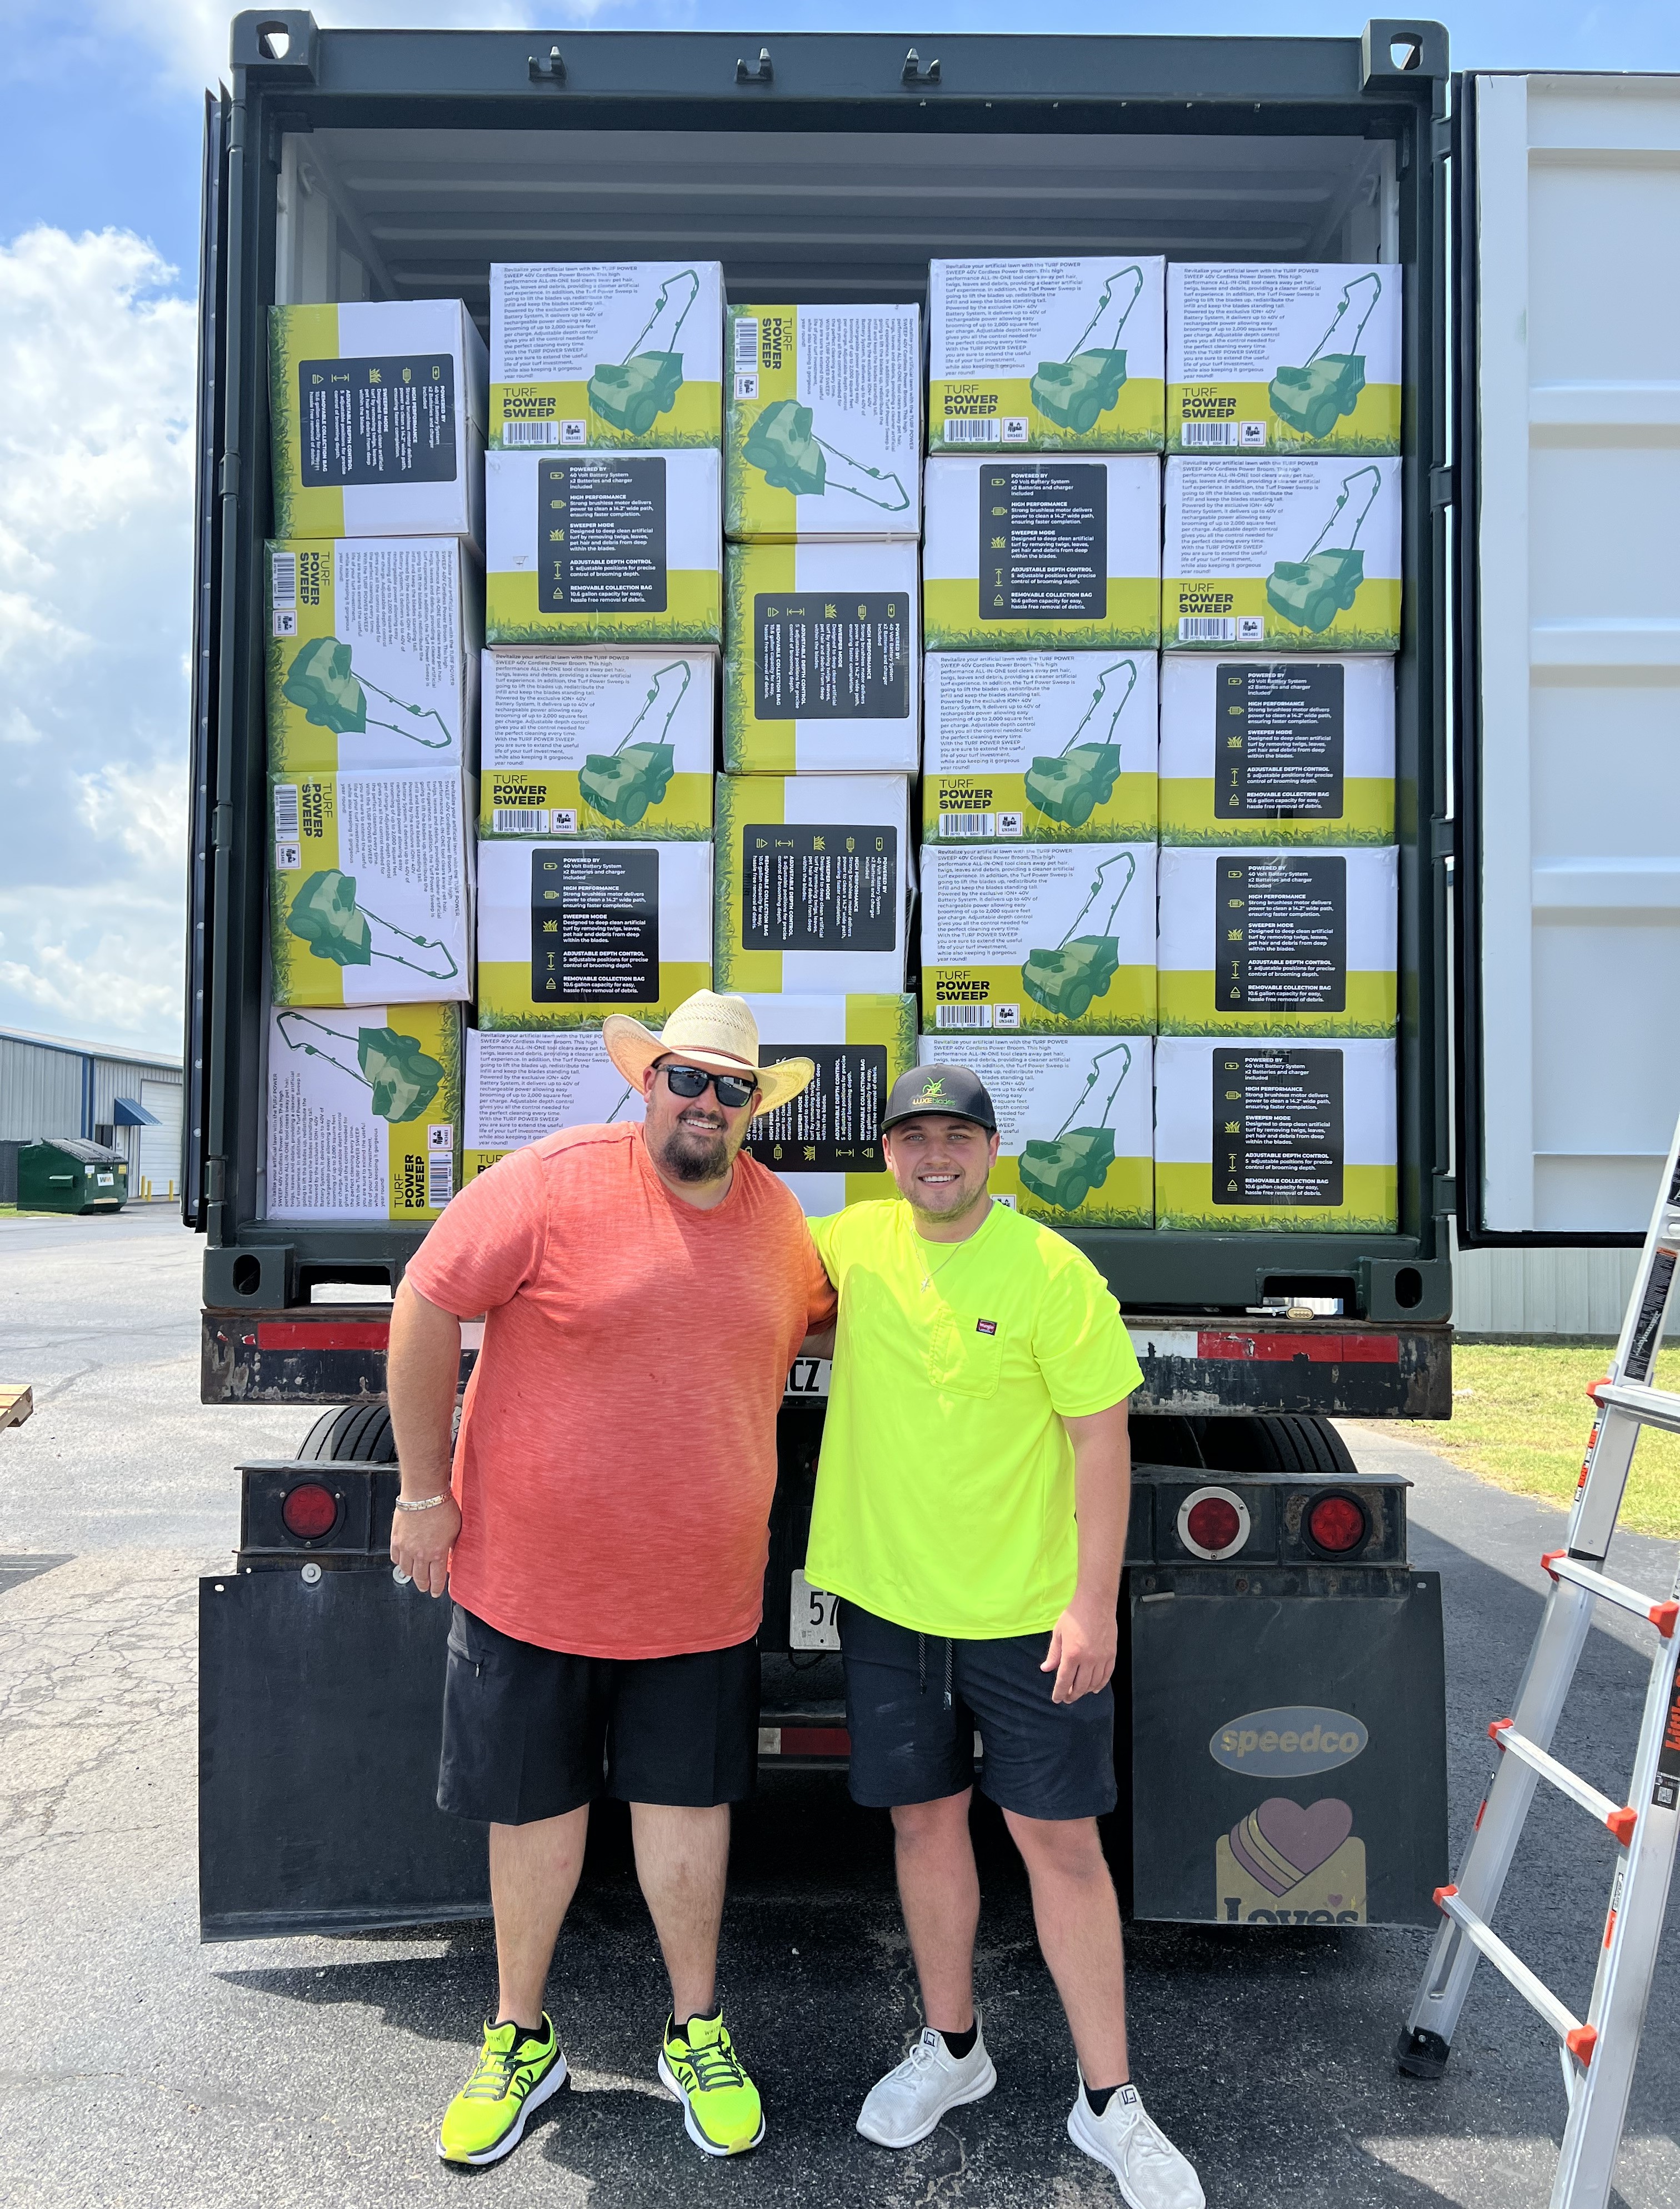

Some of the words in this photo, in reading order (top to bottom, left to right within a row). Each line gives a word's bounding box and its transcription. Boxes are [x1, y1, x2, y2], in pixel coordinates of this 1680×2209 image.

[783, 318, 792, 351] TURF
[762, 318, 771, 368] SWEEP
[773, 318, 782, 369] POWER
[503, 387, 537, 397] TURF
[944, 384, 979, 394] TURF
[1182, 387, 1217, 397] TURF
[503, 398, 556, 407] POWER
[944, 394, 998, 404] POWER
[1183, 398, 1236, 407] POWER
[503, 408, 554, 418] SWEEP
[944, 405, 996, 414] SWEEP
[1182, 409, 1234, 418] SWEEP
[321, 551, 329, 586] TURF
[300, 552, 309, 604] SWEEP
[311, 552, 319, 606] POWER
[1179, 583, 1214, 592] TURF
[1179, 593, 1233, 602] POWER
[1179, 604, 1232, 613] SWEEP
[493, 775, 527, 784] TURF
[939, 779, 973, 788] TURF
[494, 785, 547, 794] POWER
[939, 789, 993, 798] POWER
[323, 783, 333, 818] TURF
[493, 796, 545, 805] SWEEP
[939, 800, 991, 809] SWEEP
[302, 784, 312, 836] SWEEP
[312, 783, 323, 838] POWER
[936, 971, 971, 979] TURF
[937, 981, 990, 990] POWER
[936, 991, 988, 1000] SWEEP
[477, 1155, 504, 1163] TUR
[405, 1155, 414, 1207] POWER
[416, 1156, 424, 1207] SWEEP
[394, 1173, 403, 1208] TURF
[784, 1360, 821, 1392] CZ
[1221, 1725, 1359, 1757] speedco
